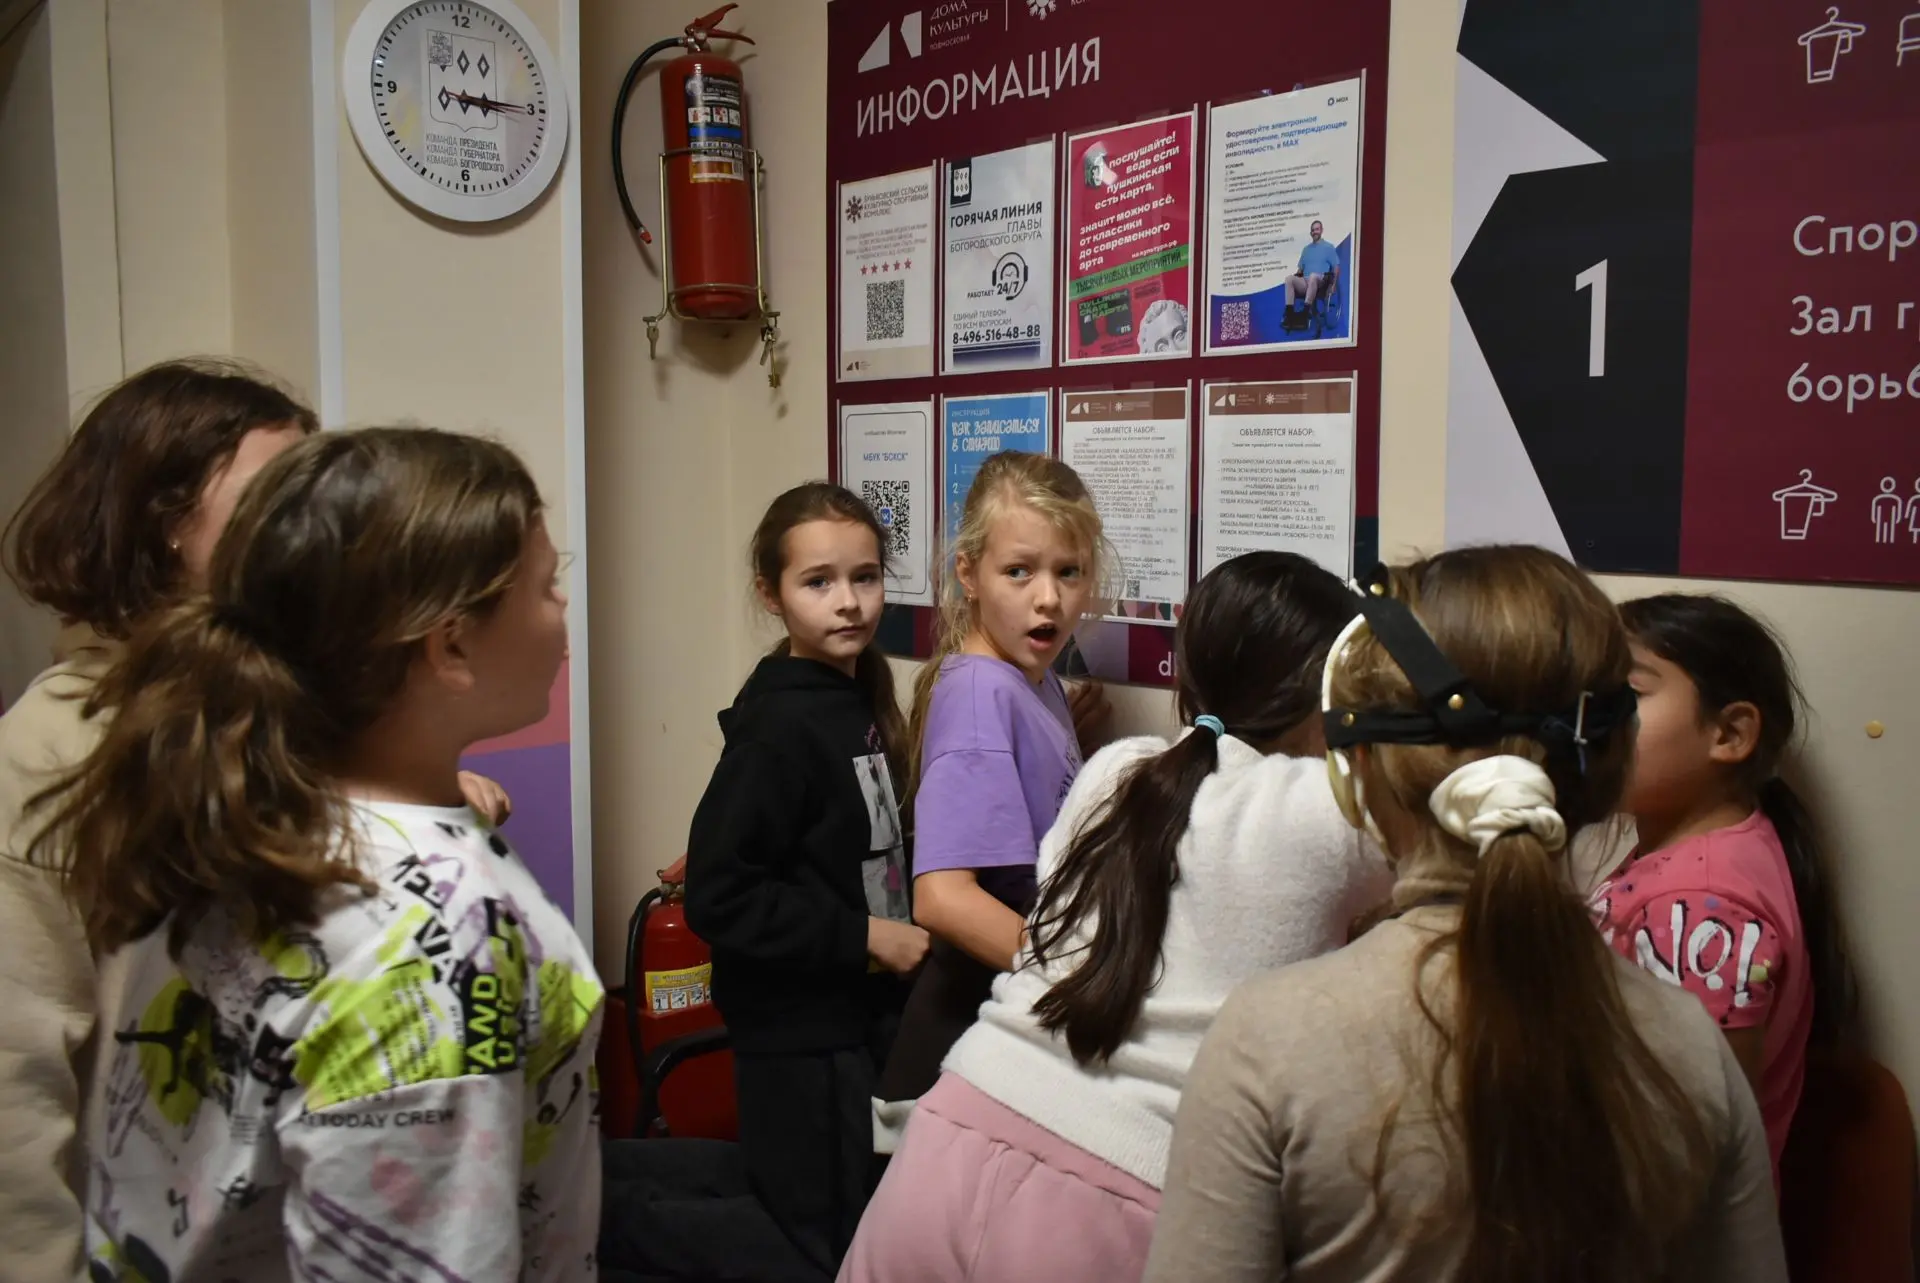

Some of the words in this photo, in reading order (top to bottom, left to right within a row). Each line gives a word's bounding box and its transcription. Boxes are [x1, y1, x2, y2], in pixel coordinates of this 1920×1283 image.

[930, 0, 967, 21] ДОМА
[452, 15, 471, 29] 12
[930, 9, 989, 37] КУЛЬТУРЫ
[387, 81, 397, 93] 9
[857, 36, 1100, 138] ИНФОРМАЦИЯ
[526, 104, 535, 116] 3
[426, 134, 457, 145] КОМАНДА
[460, 137, 498, 151] ПРЕЗИДЕНТА
[426, 144, 457, 156] КОМАНДА
[460, 148, 500, 161] ГУБЕРНАТОРА
[1109, 131, 1176, 169] послушайте!
[426, 154, 459, 167] КОМАНДА
[460, 159, 505, 173] БОГОРОДСКОГО
[1126, 158, 1151, 174] ведь
[1153, 146, 1179, 163] если
[461, 170, 470, 181] 6
[1107, 162, 1172, 194] пушкинская
[1095, 196, 1118, 210] есть
[951, 209, 998, 228] ГОРЯЧАЯ
[1000, 201, 1042, 220] ЛИНИЯ
[1080, 215, 1116, 235] значит
[1117, 203, 1151, 221] можно
[1007, 218, 1042, 233] ГЛАВЫ
[1080, 236, 1092, 247] от
[1093, 219, 1142, 242] классики
[951, 235, 1011, 253] БОГОРОДСКОГО
[1012, 230, 1042, 242] ОКРУГА
[1079, 249, 1091, 260] до
[1093, 223, 1170, 253] современного
[1793, 215, 1919, 262] Спор
[1079, 256, 1104, 271] арта
[967, 289, 994, 299] РАБОТАЕТ
[997, 280, 1020, 296] 24/7
[953, 310, 978, 321] ЕДИНЫЙ
[979, 308, 1007, 318] ТЕЛЕФОН
[963, 321, 978, 329] ВСЕМ
[979, 318, 1012, 328] ВОПРОСАМ
[1575, 259, 1608, 377] 1
[1790, 295, 1872, 335] Зал
[1897, 302, 1920, 341] г
[953, 324, 1041, 344] 8-496-516-48-88
[1239, 428, 1286, 437] ОБЪЯВЛЯЕТСЯ
[953, 483, 959, 494] 2
[320, 1112, 388, 1128] TODAY
[394, 1108, 456, 1127] CREW
